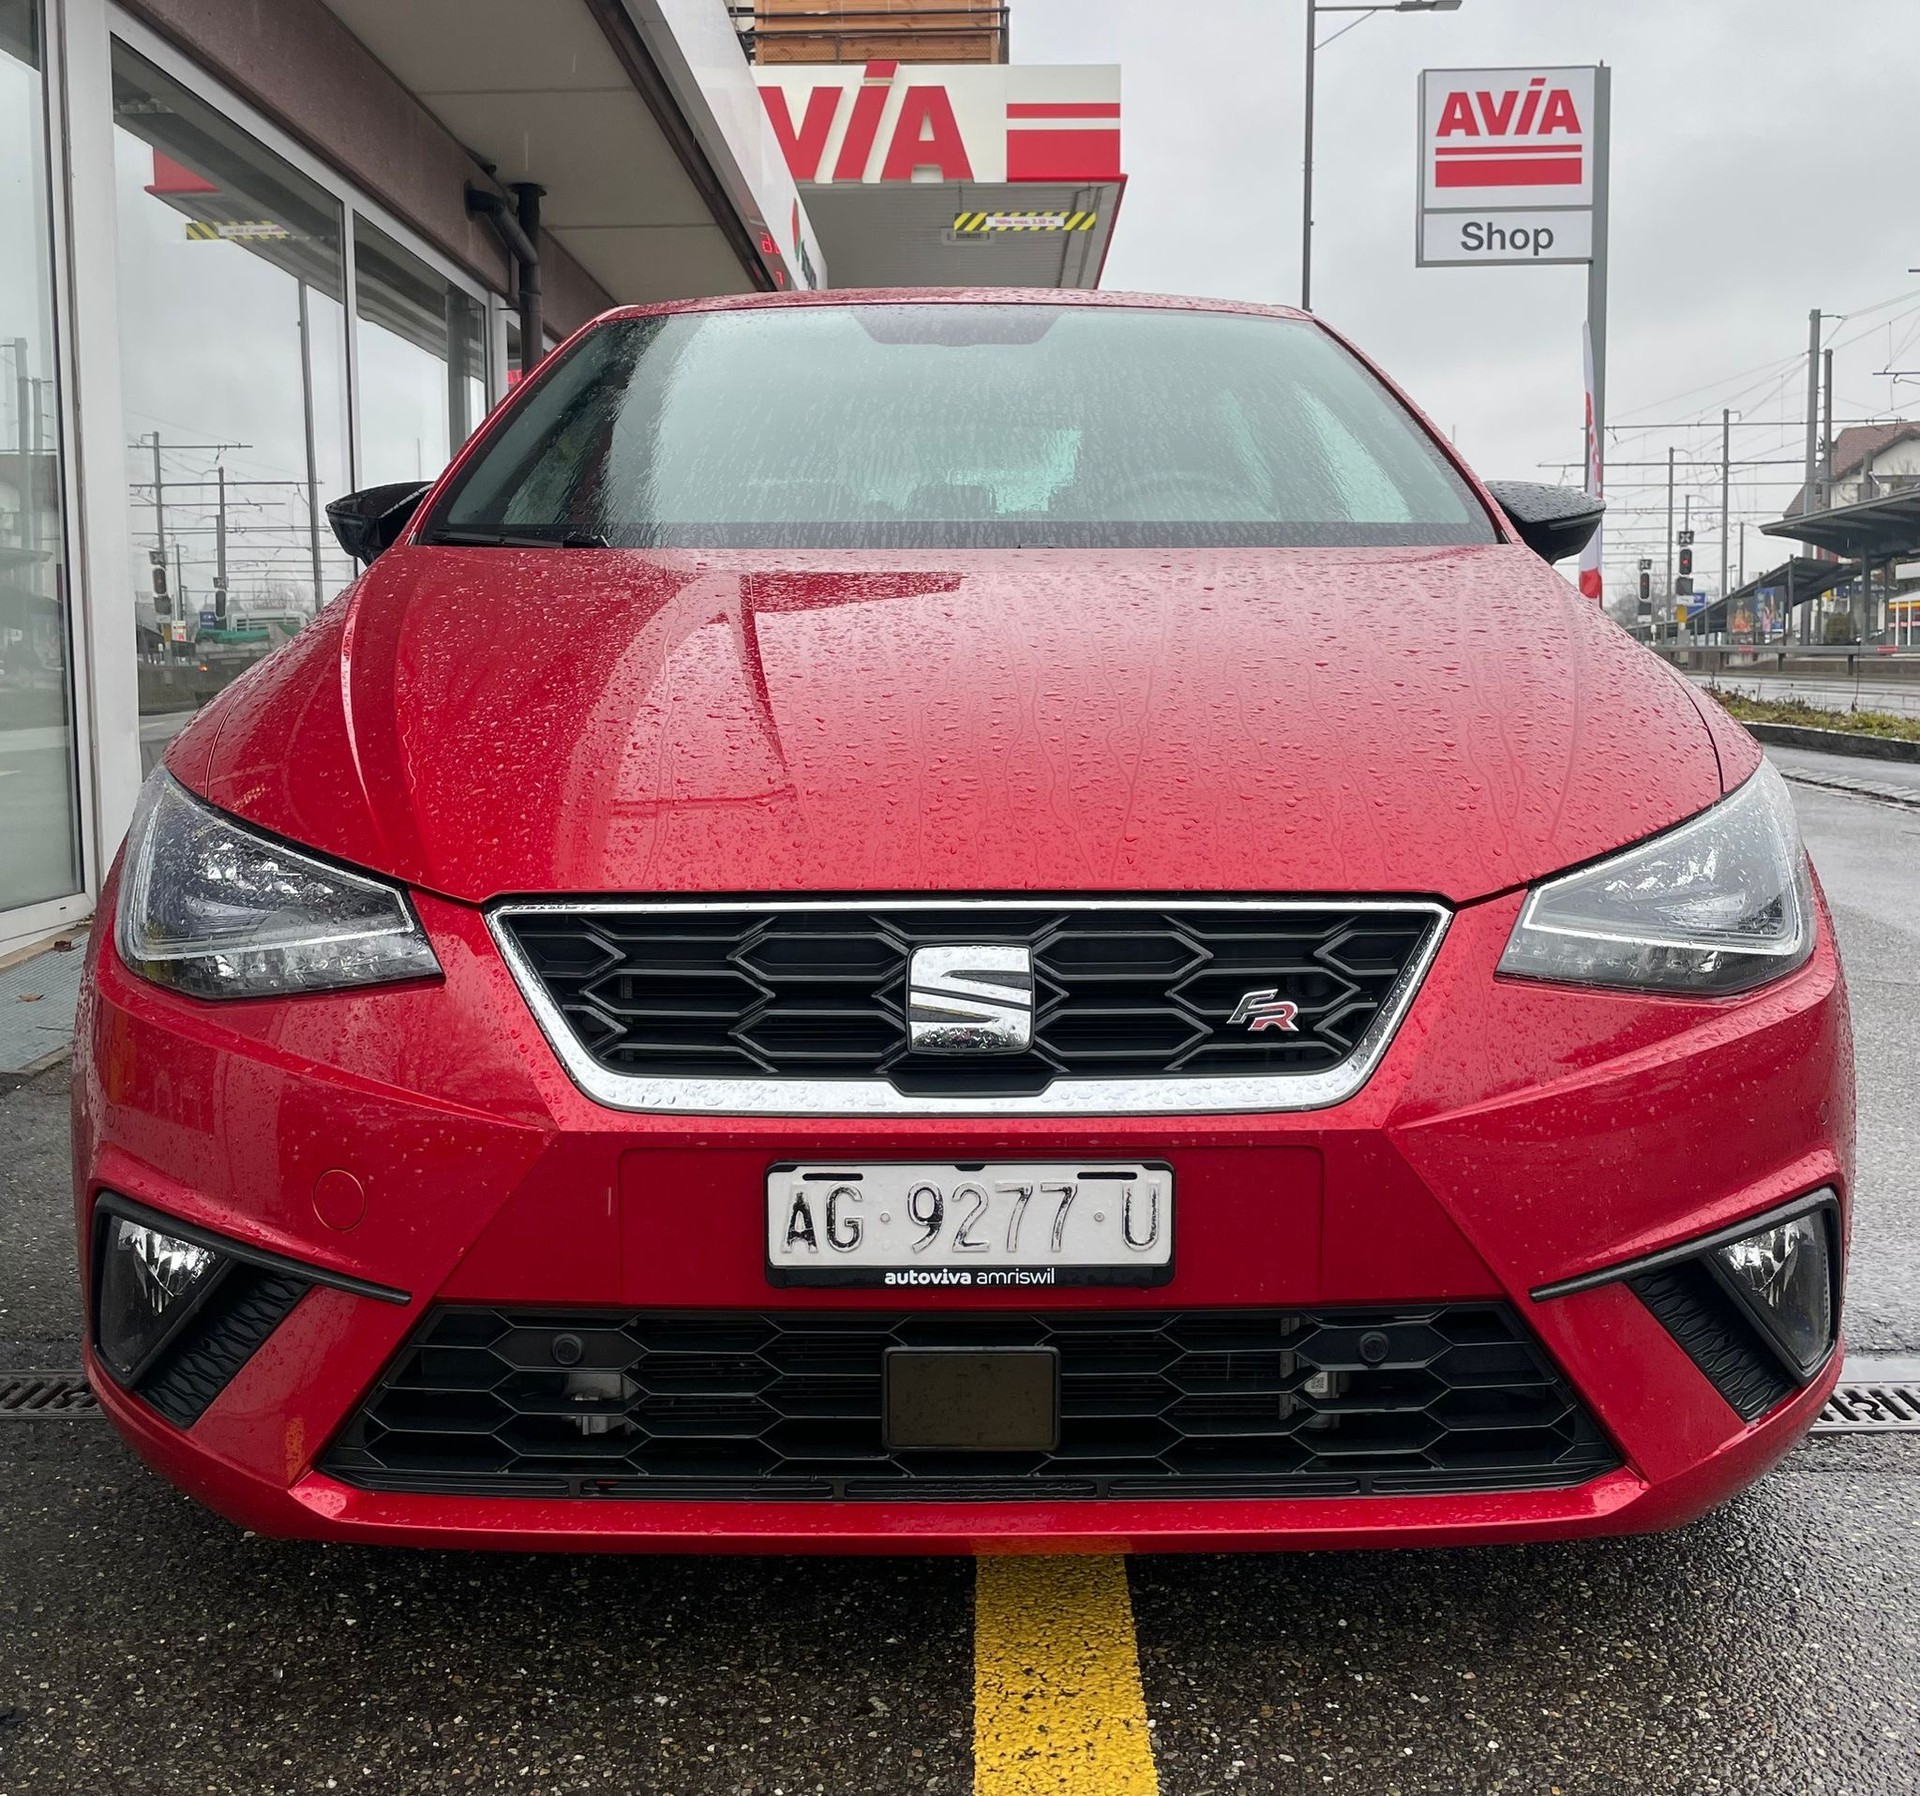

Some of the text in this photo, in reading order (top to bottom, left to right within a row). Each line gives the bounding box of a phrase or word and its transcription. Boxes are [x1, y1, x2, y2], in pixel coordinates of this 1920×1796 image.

[1436, 77, 1582, 137] AVIA
[1461, 221, 1554, 257] Shop
[1226, 988, 1299, 1032] FR
[782, 1179, 1160, 1253] AG 9277 U
[884, 1267, 1055, 1285] autoviva amriswil
